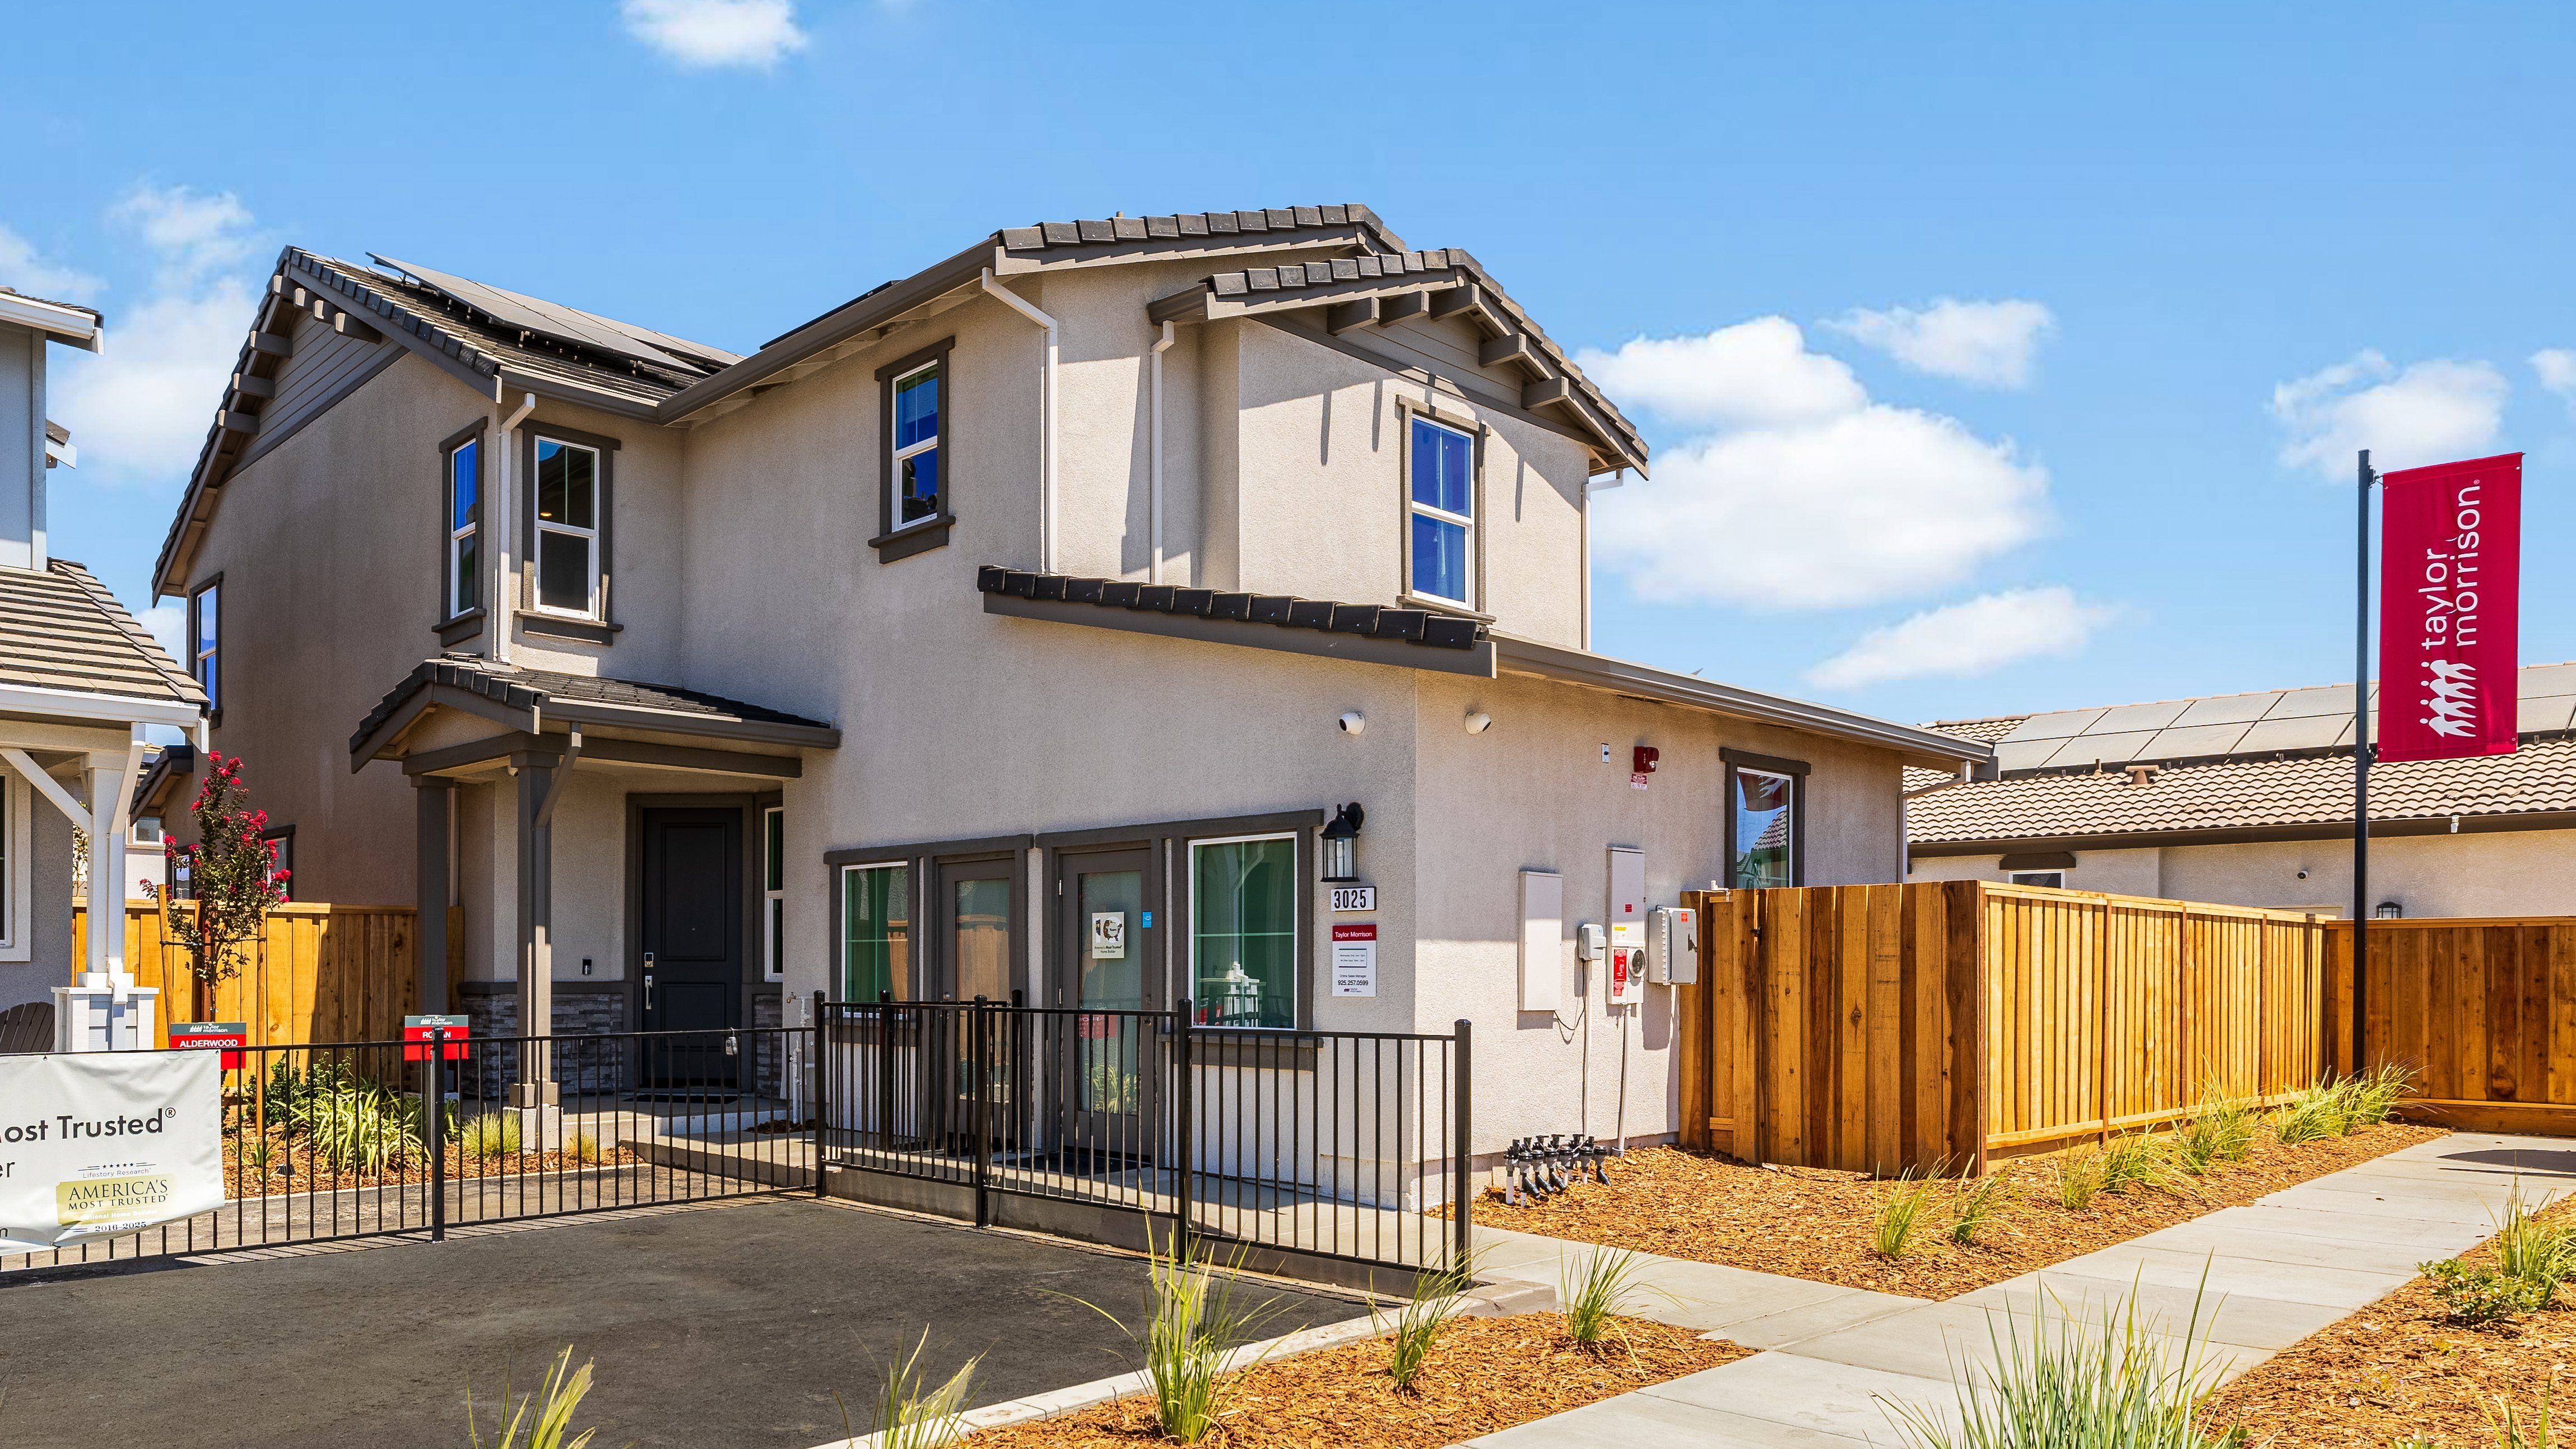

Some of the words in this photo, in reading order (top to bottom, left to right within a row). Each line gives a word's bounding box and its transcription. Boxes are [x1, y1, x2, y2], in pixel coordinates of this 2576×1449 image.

[2418, 548, 2454, 651] taylor
[1334, 889, 1366, 909] 3025
[179, 1039, 238, 1048] ALDERWOOD
[0, 1120, 49, 1143] ost
[68, 1179, 168, 1201] AMERICA'S
[68, 1200, 103, 1210] MOST
[80, 1213, 109, 1221] National
